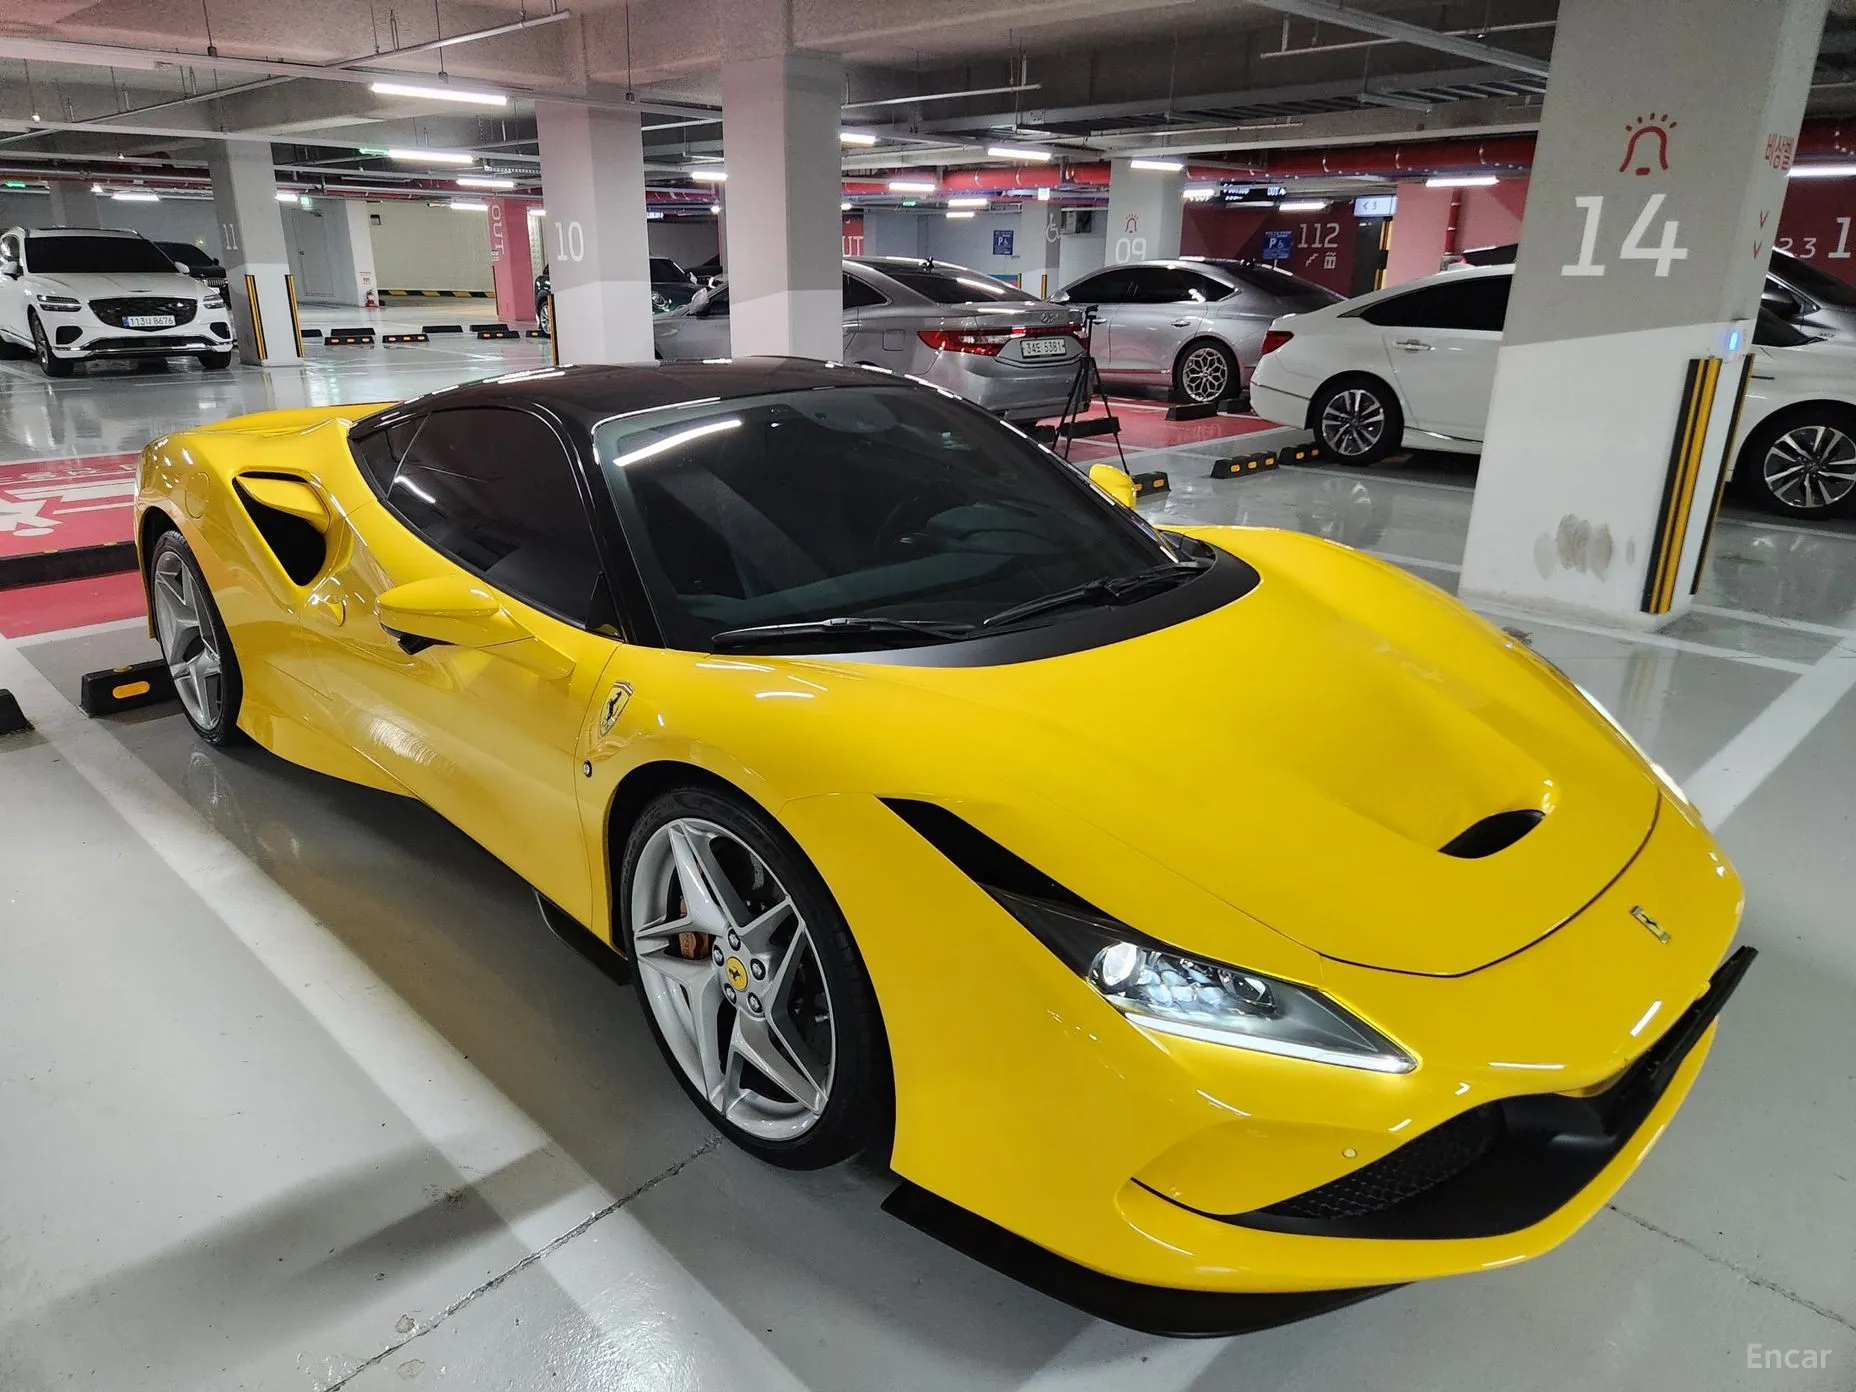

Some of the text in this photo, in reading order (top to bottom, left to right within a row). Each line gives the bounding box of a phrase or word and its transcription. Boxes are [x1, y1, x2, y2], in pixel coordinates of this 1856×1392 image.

[1763, 133, 1795, 171] 비상벨
[222, 223, 239, 250] 11
[491, 205, 505, 255] OUT
[555, 221, 585, 262] 10
[842, 235, 864, 257] UT
[1297, 223, 1340, 248] 112
[1560, 194, 1688, 277] 14
[1115, 237, 1147, 264] 09
